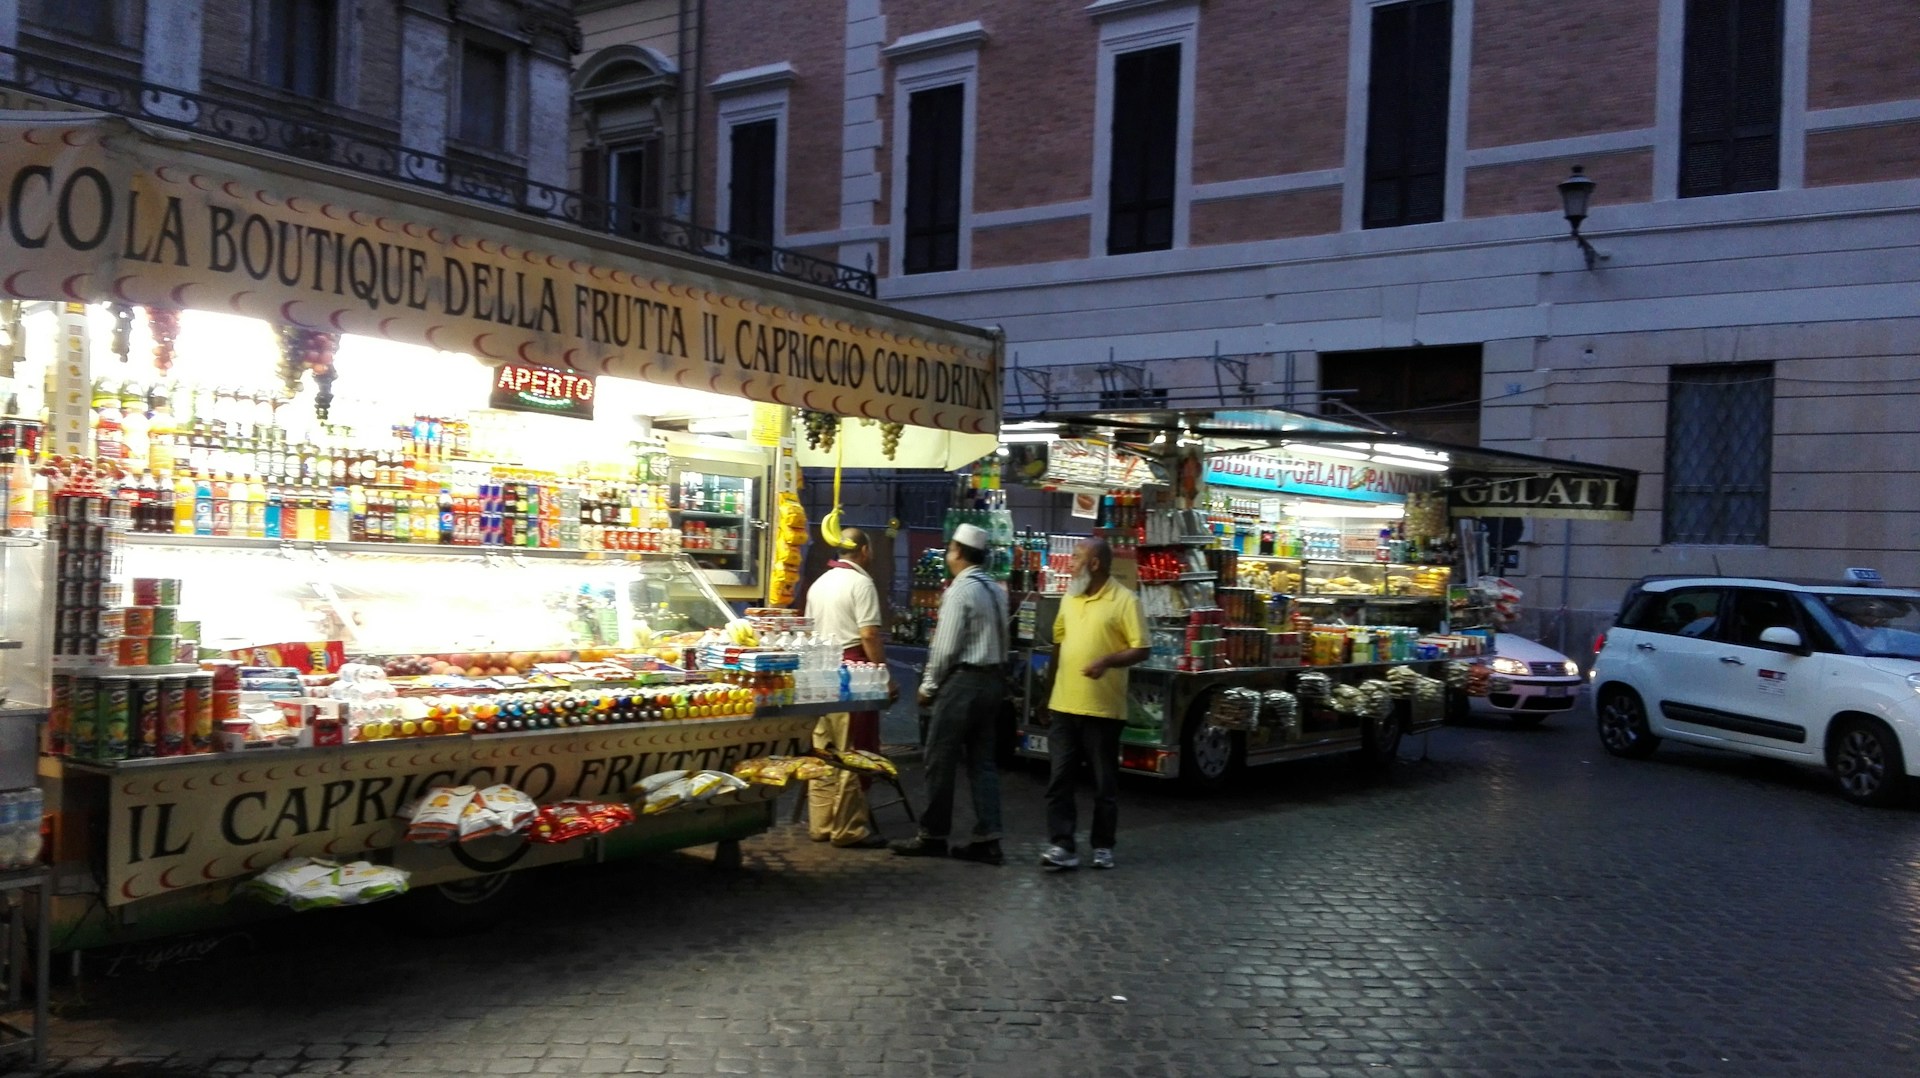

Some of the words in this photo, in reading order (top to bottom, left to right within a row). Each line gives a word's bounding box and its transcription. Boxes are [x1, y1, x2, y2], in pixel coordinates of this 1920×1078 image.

[9, 165, 113, 251] CO
[123, 190, 190, 268] LA
[208, 204, 427, 311] BOUTIQUE
[443, 256, 561, 335] DELLA
[575, 283, 687, 359] FRUTTA
[703, 312, 725, 365] IL
[735, 319, 864, 390] CAPRICCIO
[873, 348, 929, 400] COLD
[935, 360, 993, 410] DRINK
[498, 366, 593, 400] APERTO
[1291, 459, 1354, 491] GELATI
[1459, 475, 1621, 507] GELATI
[127, 803, 194, 865] IL
